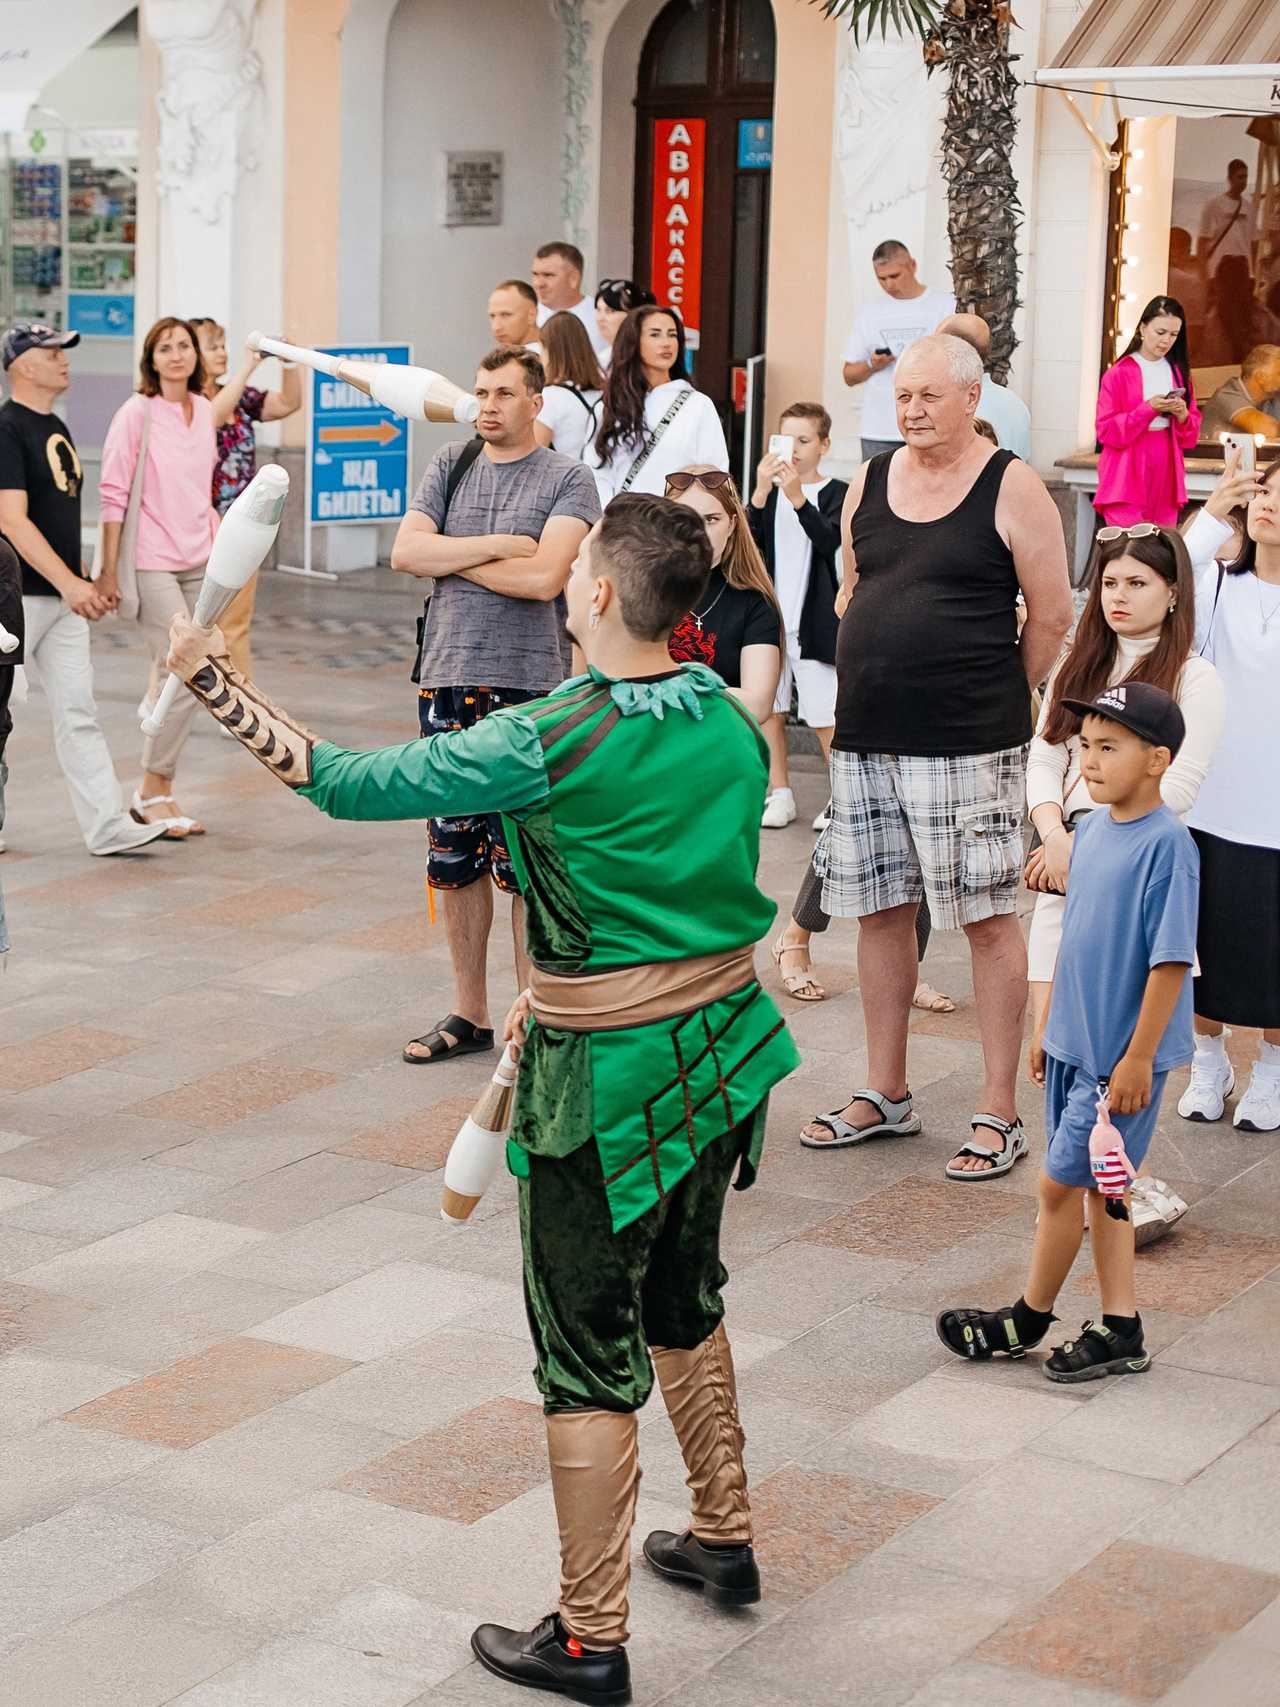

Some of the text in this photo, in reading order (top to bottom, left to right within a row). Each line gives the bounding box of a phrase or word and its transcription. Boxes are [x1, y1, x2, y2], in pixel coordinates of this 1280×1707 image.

[320, 381, 384, 409] БИЛЕ
[342, 459, 378, 489] ЖД
[317, 488, 401, 518] БИЛЕТЫ
[1096, 697, 1125, 711] adidas
